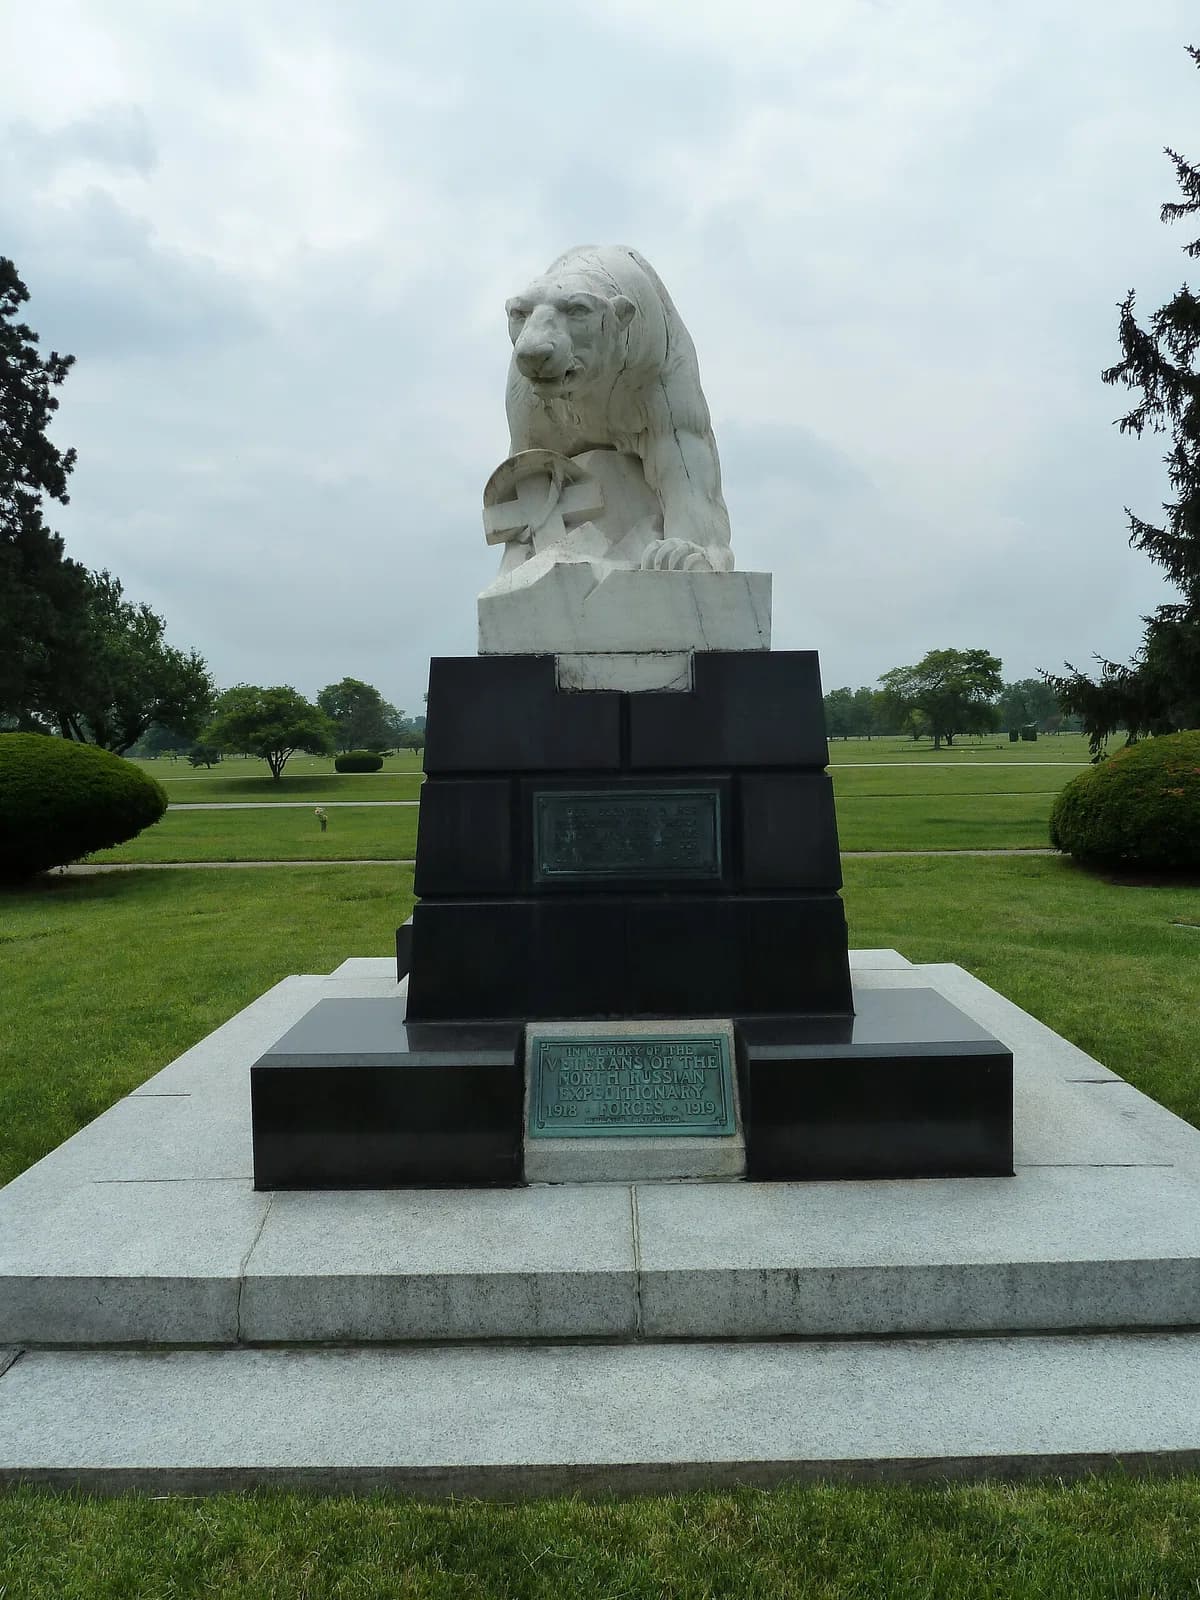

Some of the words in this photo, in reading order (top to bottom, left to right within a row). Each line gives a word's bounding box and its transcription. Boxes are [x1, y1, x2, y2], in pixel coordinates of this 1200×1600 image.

[567, 1047, 580, 1057] IN
[587, 1046, 641, 1056] MEMORY
[646, 1046, 660, 1055] OF
[667, 1045, 693, 1055] THE
[545, 1056, 643, 1071] VETERANS
[650, 1056, 672, 1069] OF
[680, 1055, 717, 1069] THE
[560, 1071, 620, 1086] NORTH
[630, 1069, 704, 1085] RUSSIAN
[560, 1085, 704, 1101] EXPEDITIONARY
[547, 1104, 577, 1117] 1918
[600, 1101, 663, 1116] FORCES
[686, 1101, 714, 1115] 1919
